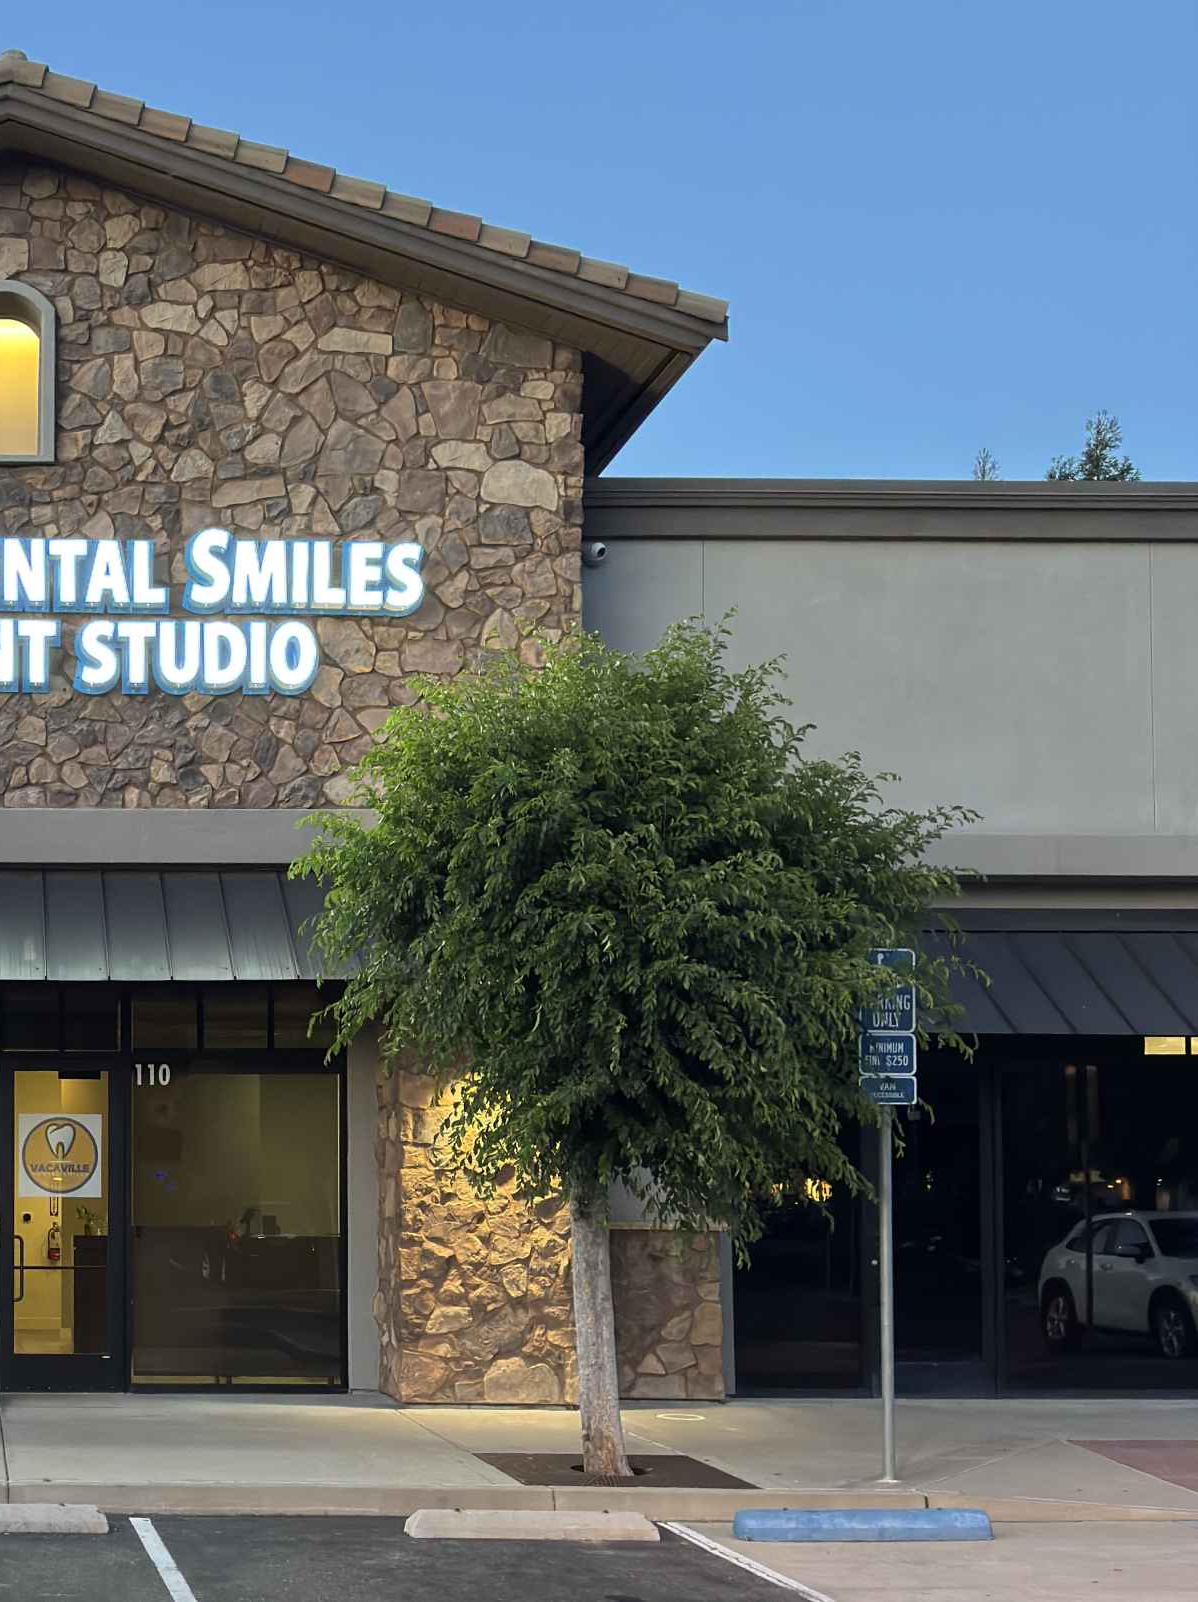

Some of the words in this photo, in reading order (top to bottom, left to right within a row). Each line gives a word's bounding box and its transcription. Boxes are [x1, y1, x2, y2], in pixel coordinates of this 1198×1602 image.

[183, 528, 424, 617] SMILES
[74, 620, 319, 695] STUDIO
[865, 994, 911, 1010] KING
[872, 1011, 901, 1028] ONLY
[886, 1055, 909, 1066] $250
[134, 1063, 171, 1086] 110
[871, 1091, 905, 1099] CCESSIBLE
[30, 1163, 91, 1173] VACAVILLE
